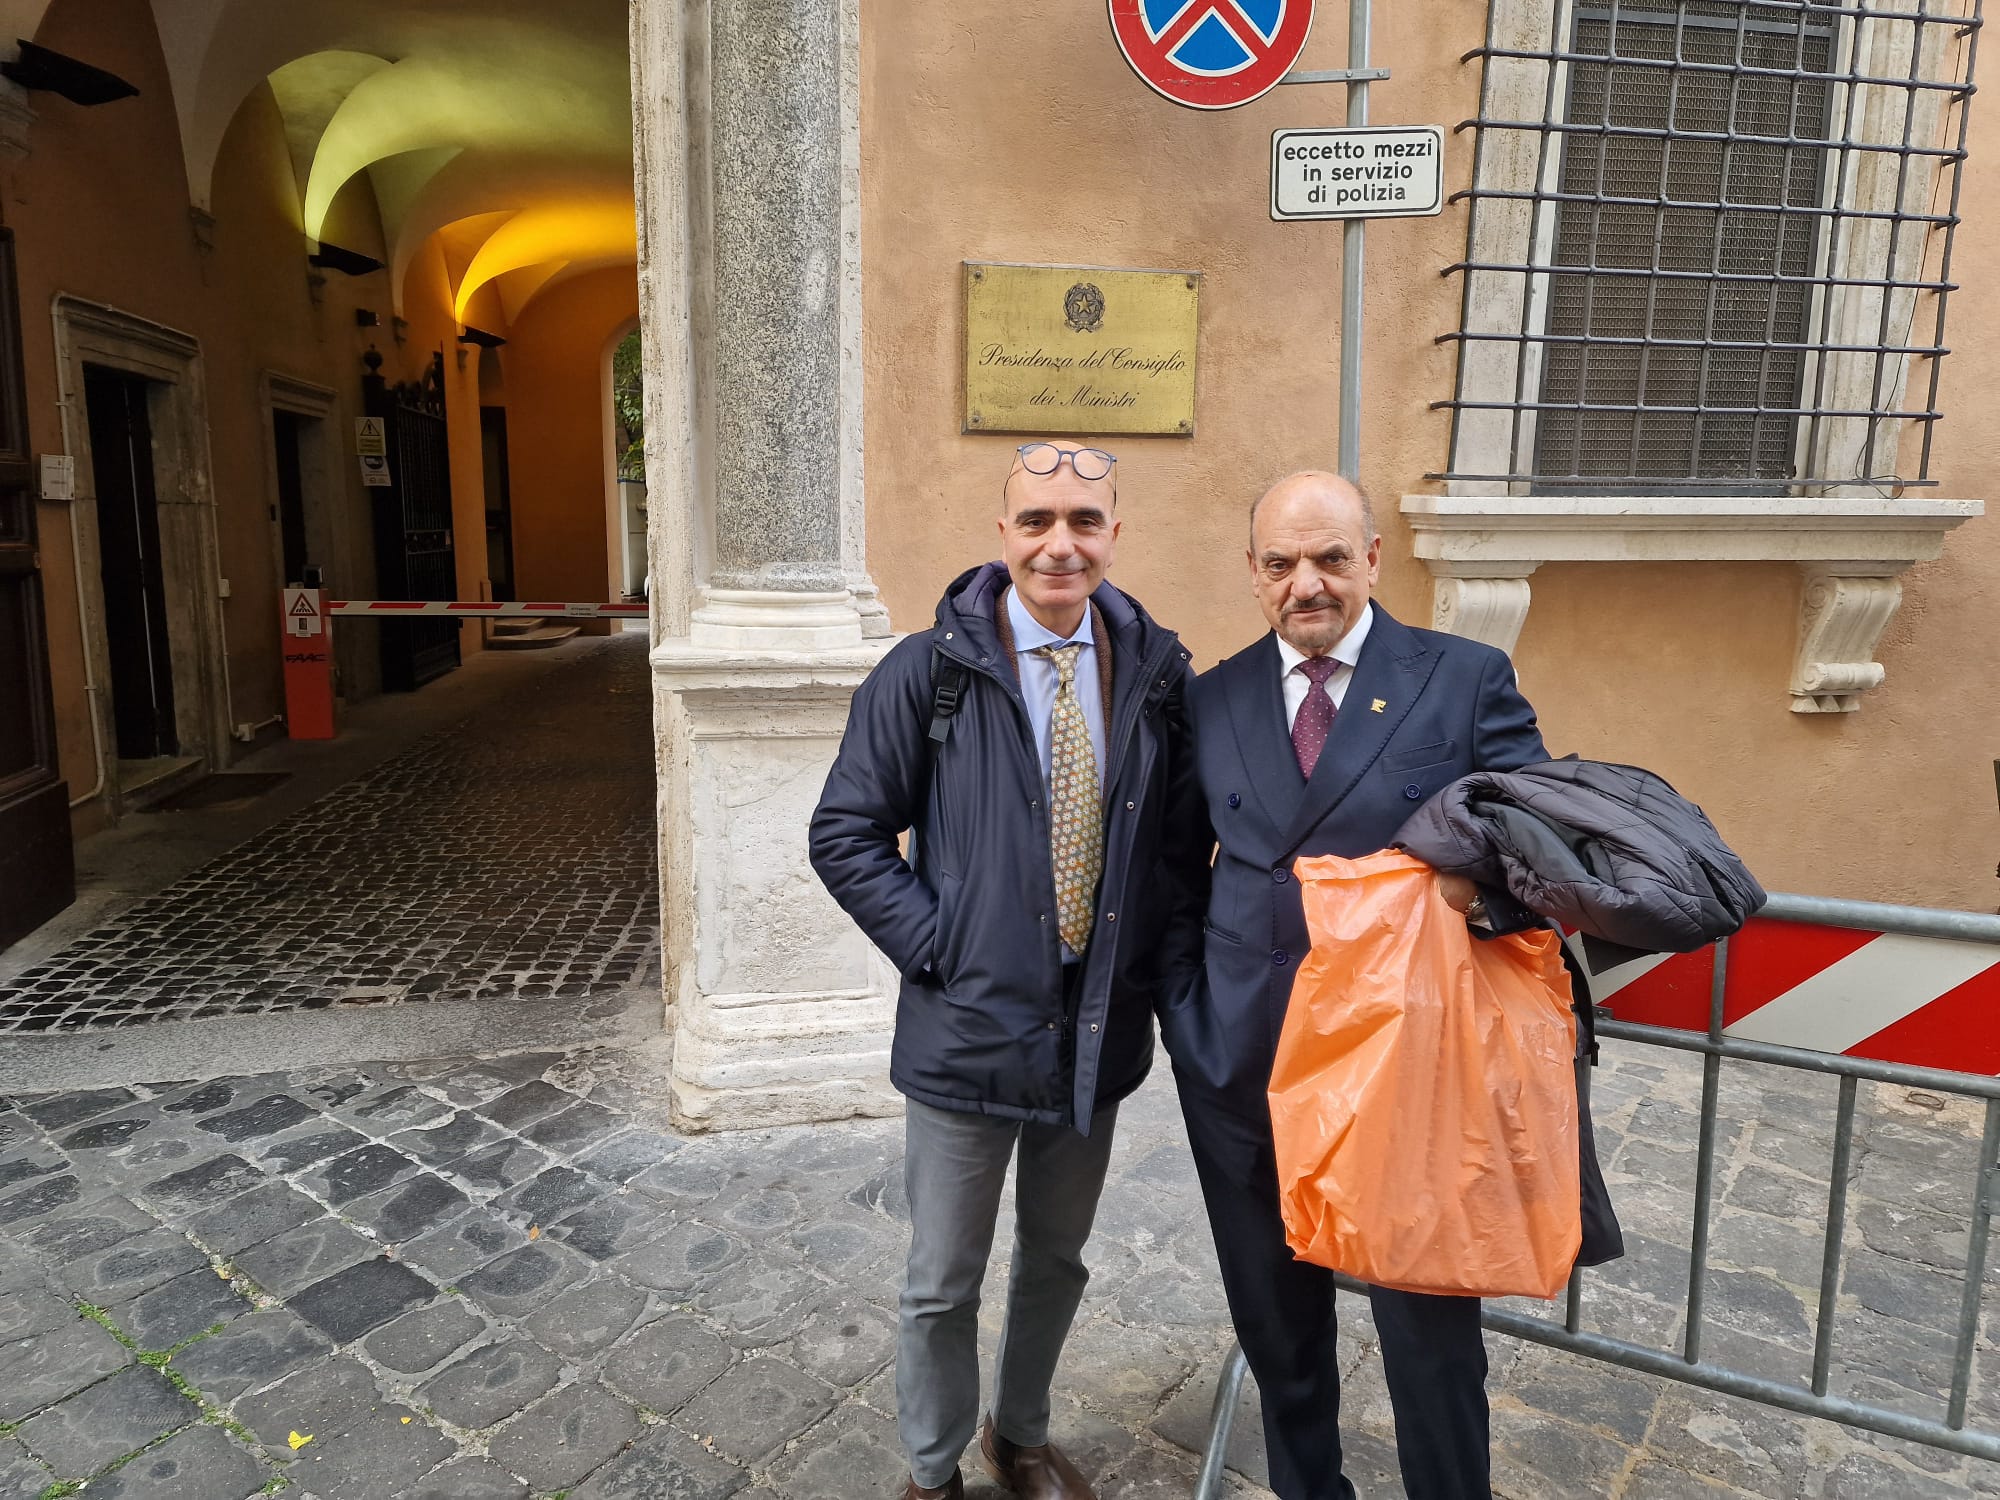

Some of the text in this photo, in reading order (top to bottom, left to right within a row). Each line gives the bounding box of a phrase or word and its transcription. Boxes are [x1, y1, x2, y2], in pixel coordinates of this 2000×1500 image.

[1284, 138, 1432, 160] eccetto mezzi
[1303, 161, 1413, 181] in servizio
[1307, 183, 1406, 206] di polizia
[978, 343, 1187, 378] Presidenza del Consiglio
[1029, 384, 1140, 408] dei Ministri
